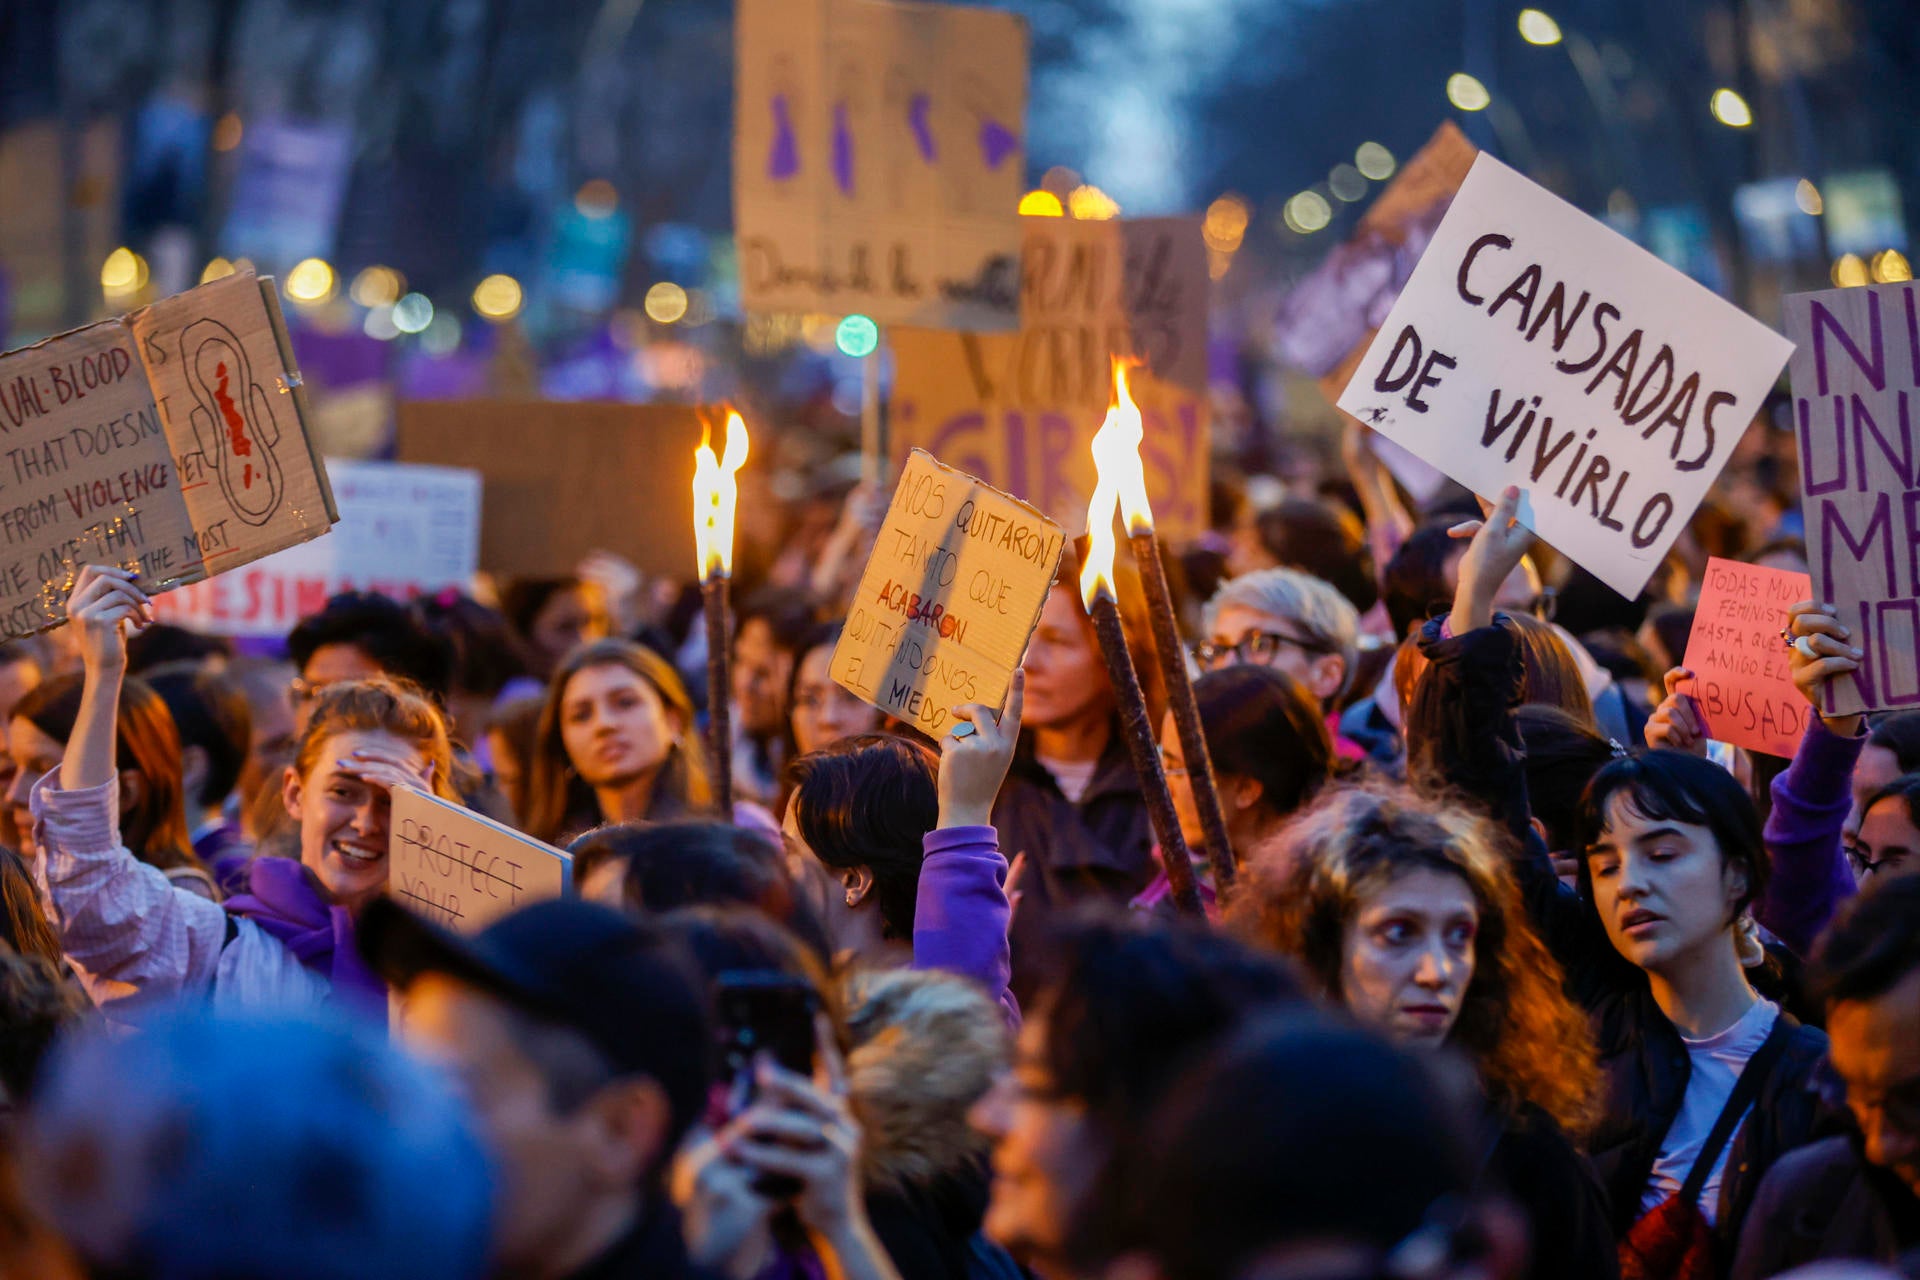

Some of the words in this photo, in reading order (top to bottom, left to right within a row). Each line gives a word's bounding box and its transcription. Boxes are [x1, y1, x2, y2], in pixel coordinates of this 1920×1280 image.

[143, 330, 167, 365] IS
[1374, 325, 1457, 413] DE
[1457, 233, 1737, 471] CANSADAS
[6, 437, 69, 485] THAT
[1798, 390, 1920, 496] UN
[1, 494, 59, 544] FROM
[64, 464, 168, 519] VIOLENCE
[175, 451, 206, 483] YET
[896, 469, 945, 519] NOS
[956, 500, 1055, 569] QUITARON
[37, 540, 87, 583] ONE
[85, 511, 145, 557] THAT
[138, 547, 174, 575] THE
[183, 519, 228, 560] MOST
[895, 528, 958, 587] TANTO
[969, 570, 1012, 615] QUE
[876, 579, 968, 644] ACABARON
[1767, 577, 1805, 601] MUY
[1697, 622, 1743, 646] HASTA
[1751, 632, 1776, 653] QUE
[1764, 660, 1786, 682] EL
[844, 657, 871, 693] EL
[889, 679, 947, 729] MIEDO
[400, 818, 523, 906] PROTECT
[400, 872, 462, 931] YOUR
